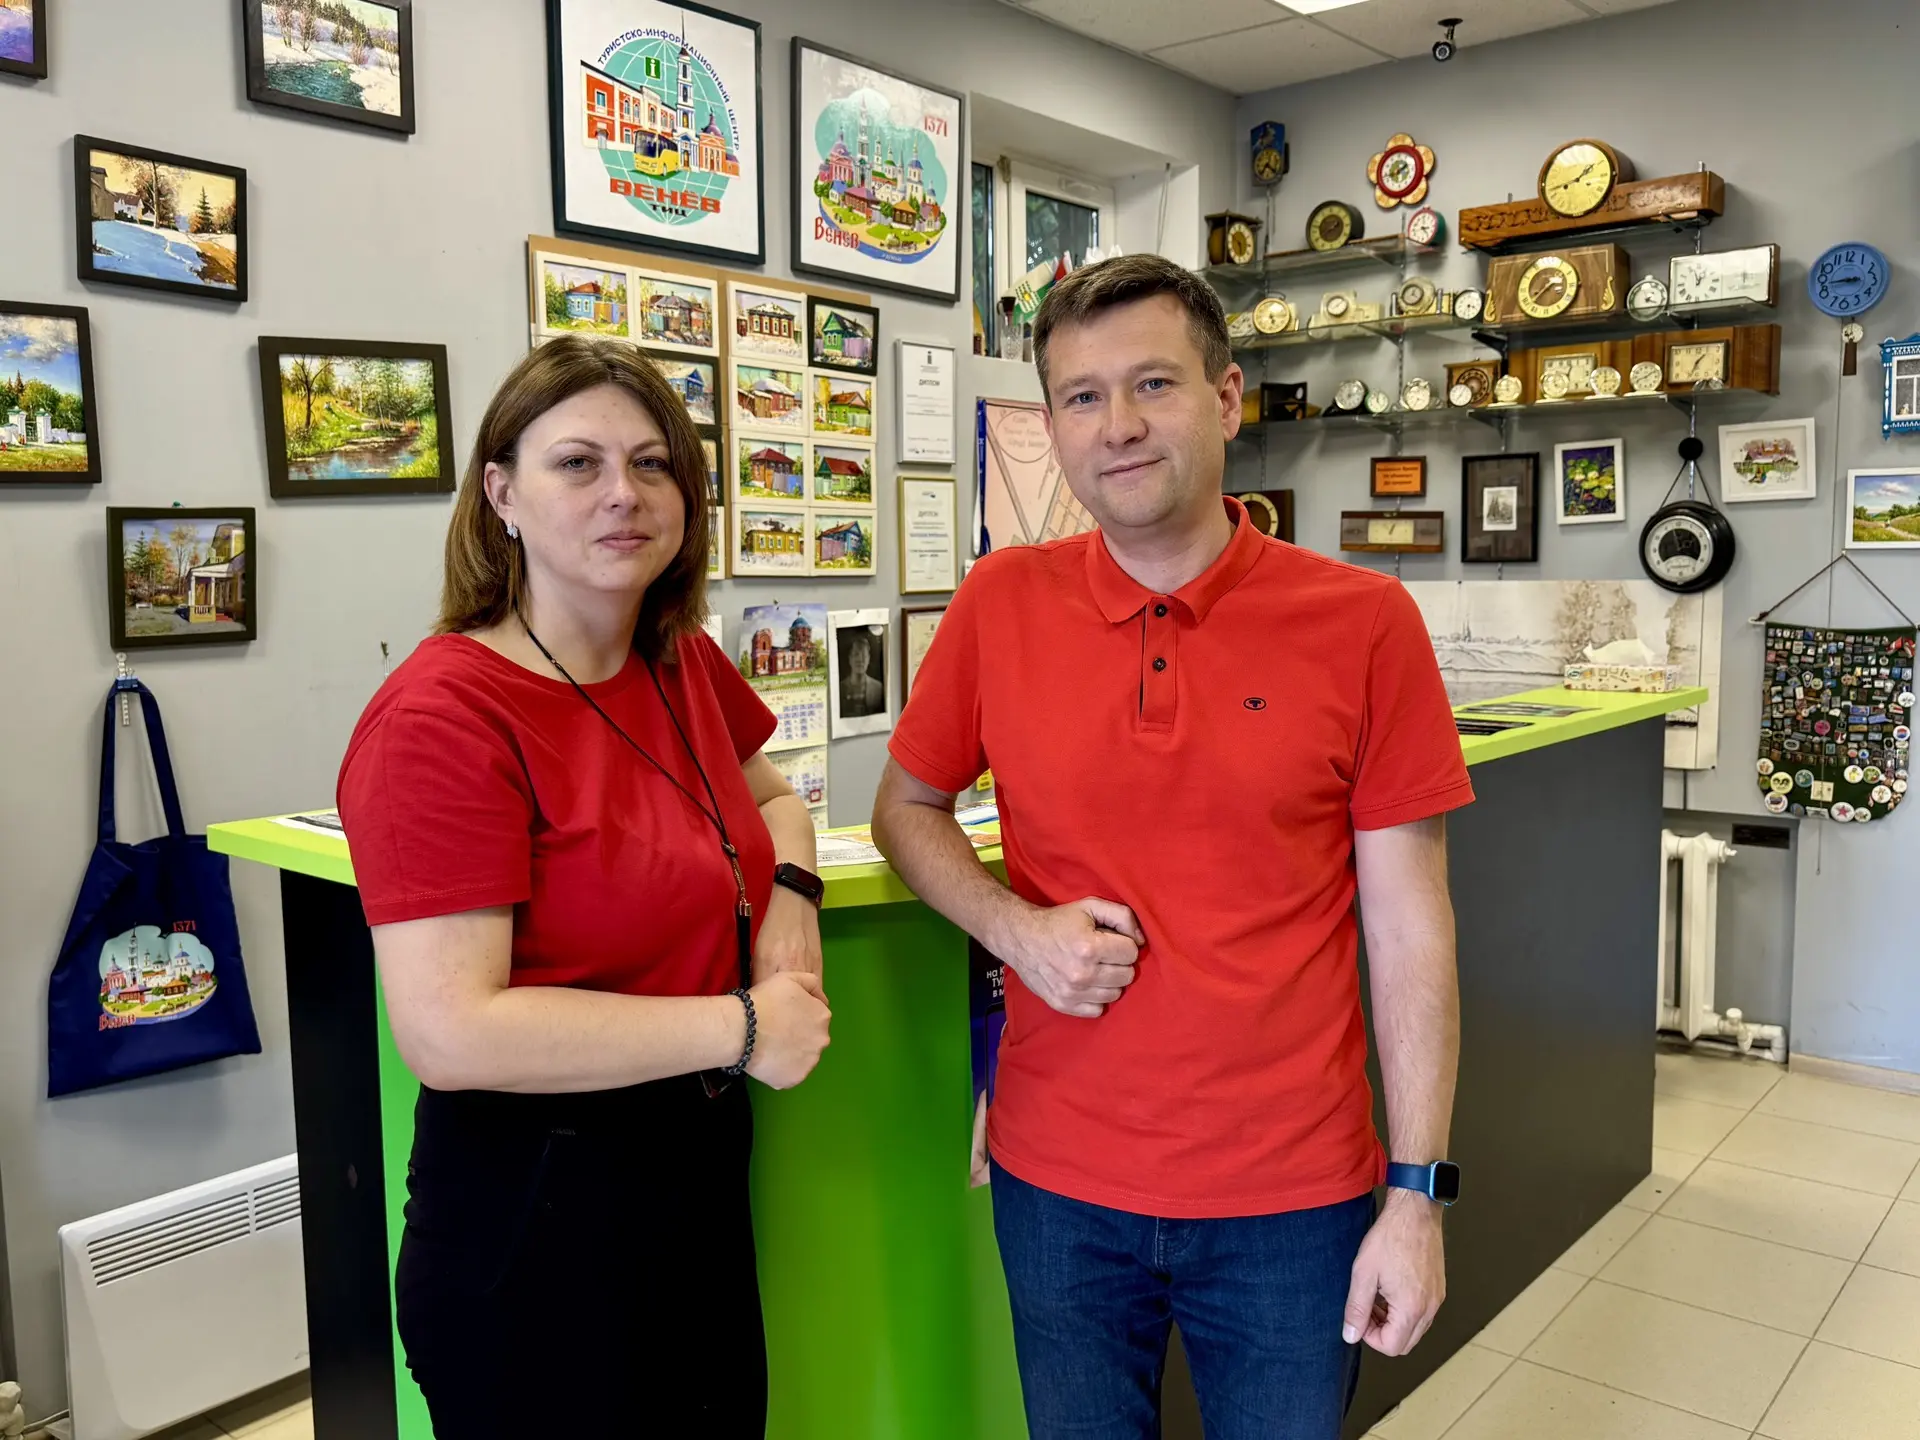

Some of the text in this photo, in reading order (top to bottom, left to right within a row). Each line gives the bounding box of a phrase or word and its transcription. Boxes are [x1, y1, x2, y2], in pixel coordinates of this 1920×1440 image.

[728, 109, 740, 150] ЦЕНТР
[924, 114, 947, 137] 1371
[650, 203, 688, 217] ТИЦ
[1834, 254, 1841, 265] 11
[1846, 250, 1855, 262] 12
[1861, 253, 1865, 265] 1
[1821, 263, 1833, 274] 10
[1867, 262, 1875, 274] 2
[1817, 274, 1827, 286] 9
[1870, 272, 1877, 286] 3
[1819, 285, 1829, 299] 8
[1863, 287, 1872, 297] 4
[1829, 296, 1838, 307] 7
[1839, 297, 1849, 310] 6
[1853, 294, 1861, 306] 5
[173, 920, 196, 931] 1371
